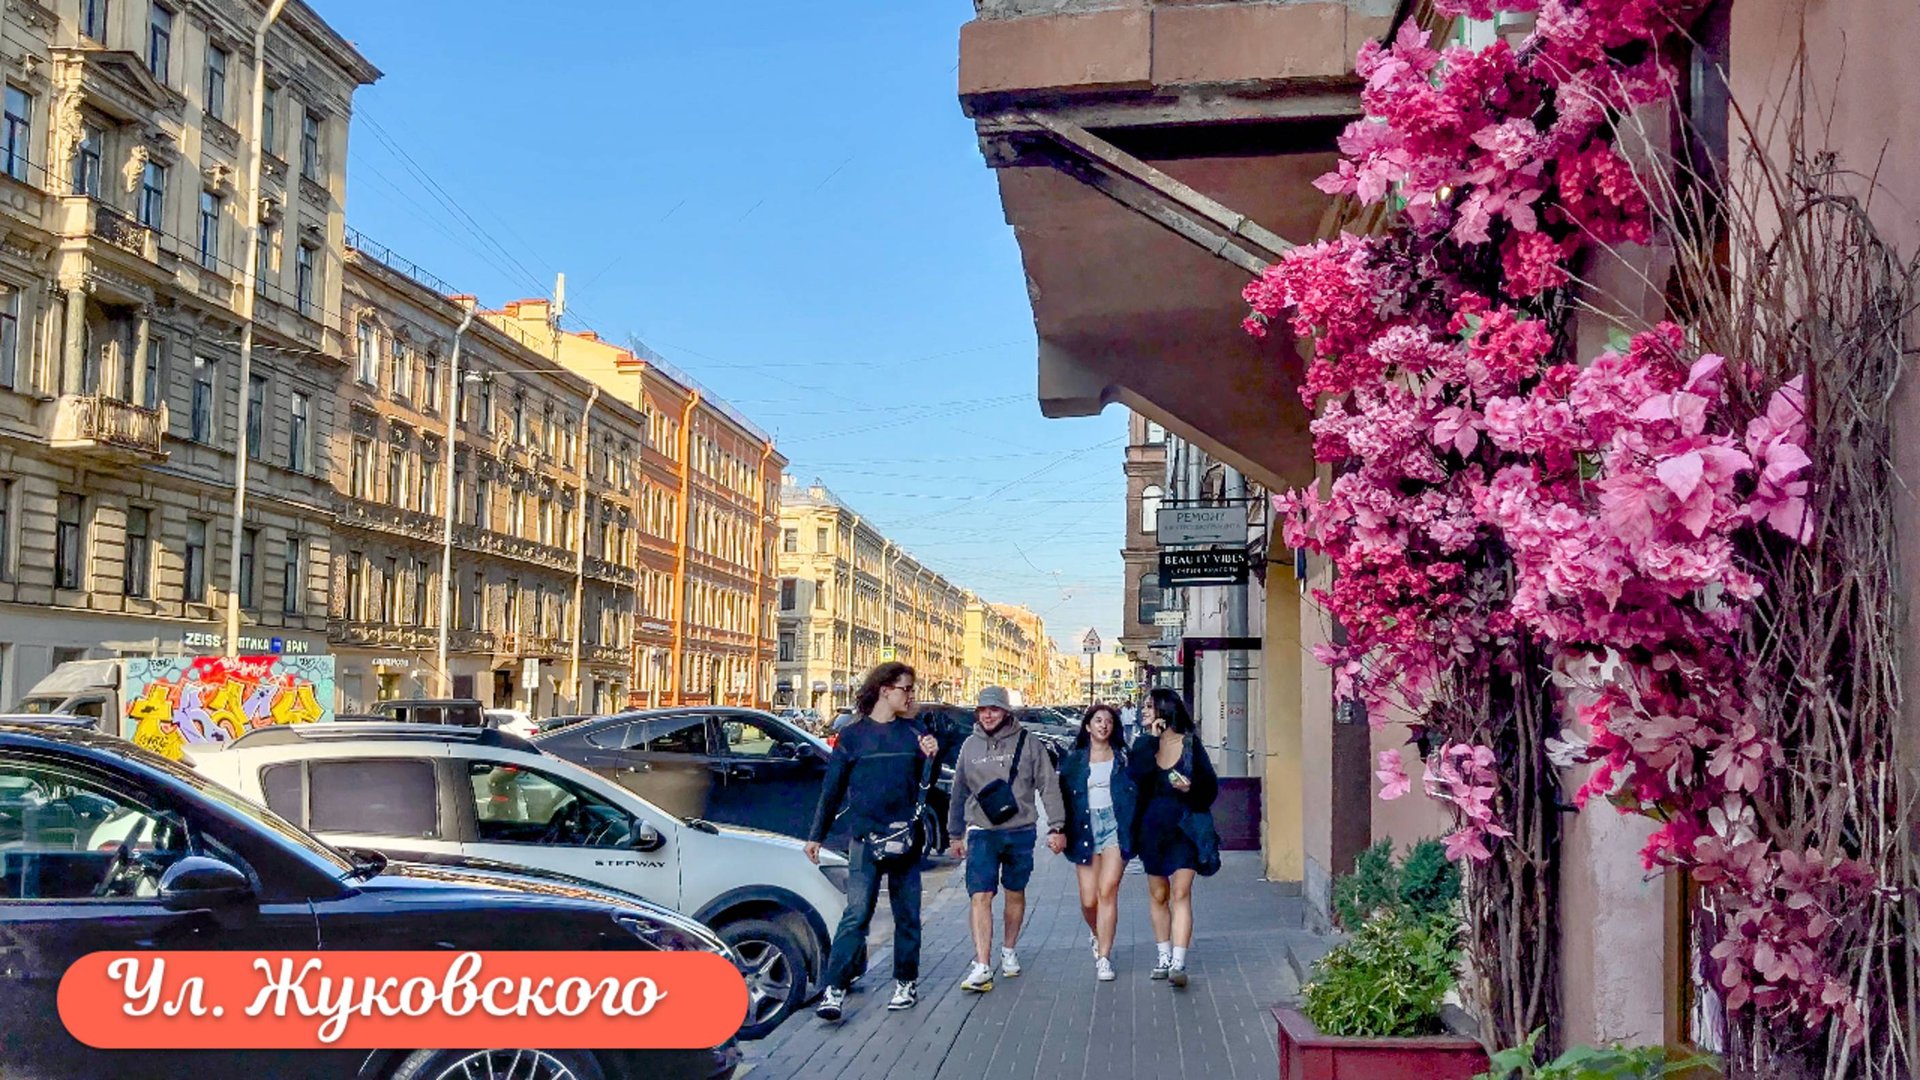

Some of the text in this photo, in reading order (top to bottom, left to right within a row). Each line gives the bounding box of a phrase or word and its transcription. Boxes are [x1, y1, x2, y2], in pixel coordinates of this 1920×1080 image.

[1165, 553, 1245, 565] BEAUTY VIBES
[185, 632, 222, 647] ZEISS
[237, 636, 270, 650] ПТИКА
[285, 640, 309, 653] ВРАЧ
[595, 859, 666, 868] STEPWAY
